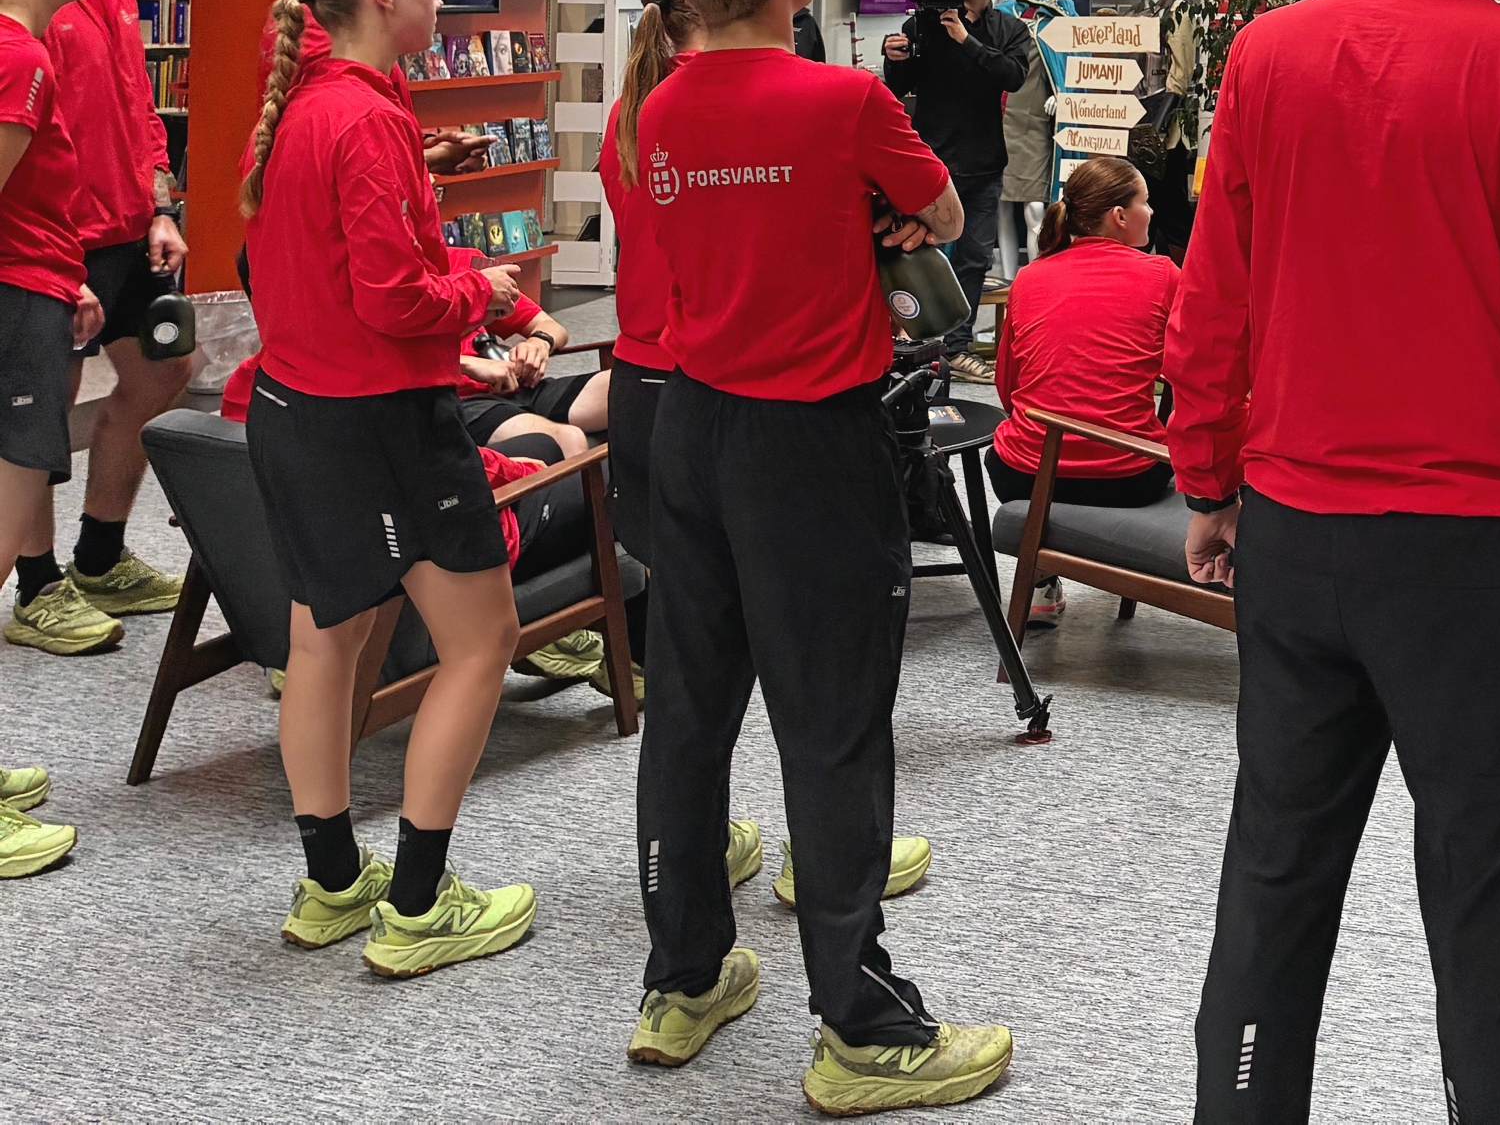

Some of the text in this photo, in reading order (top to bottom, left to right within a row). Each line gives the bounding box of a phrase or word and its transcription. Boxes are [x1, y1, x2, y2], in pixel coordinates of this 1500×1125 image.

[1072, 22, 1142, 48] Neverland
[1076, 61, 1123, 86] JUMANJI
[1065, 97, 1127, 120] Wonderland
[686, 166, 793, 188] FORSVARET
